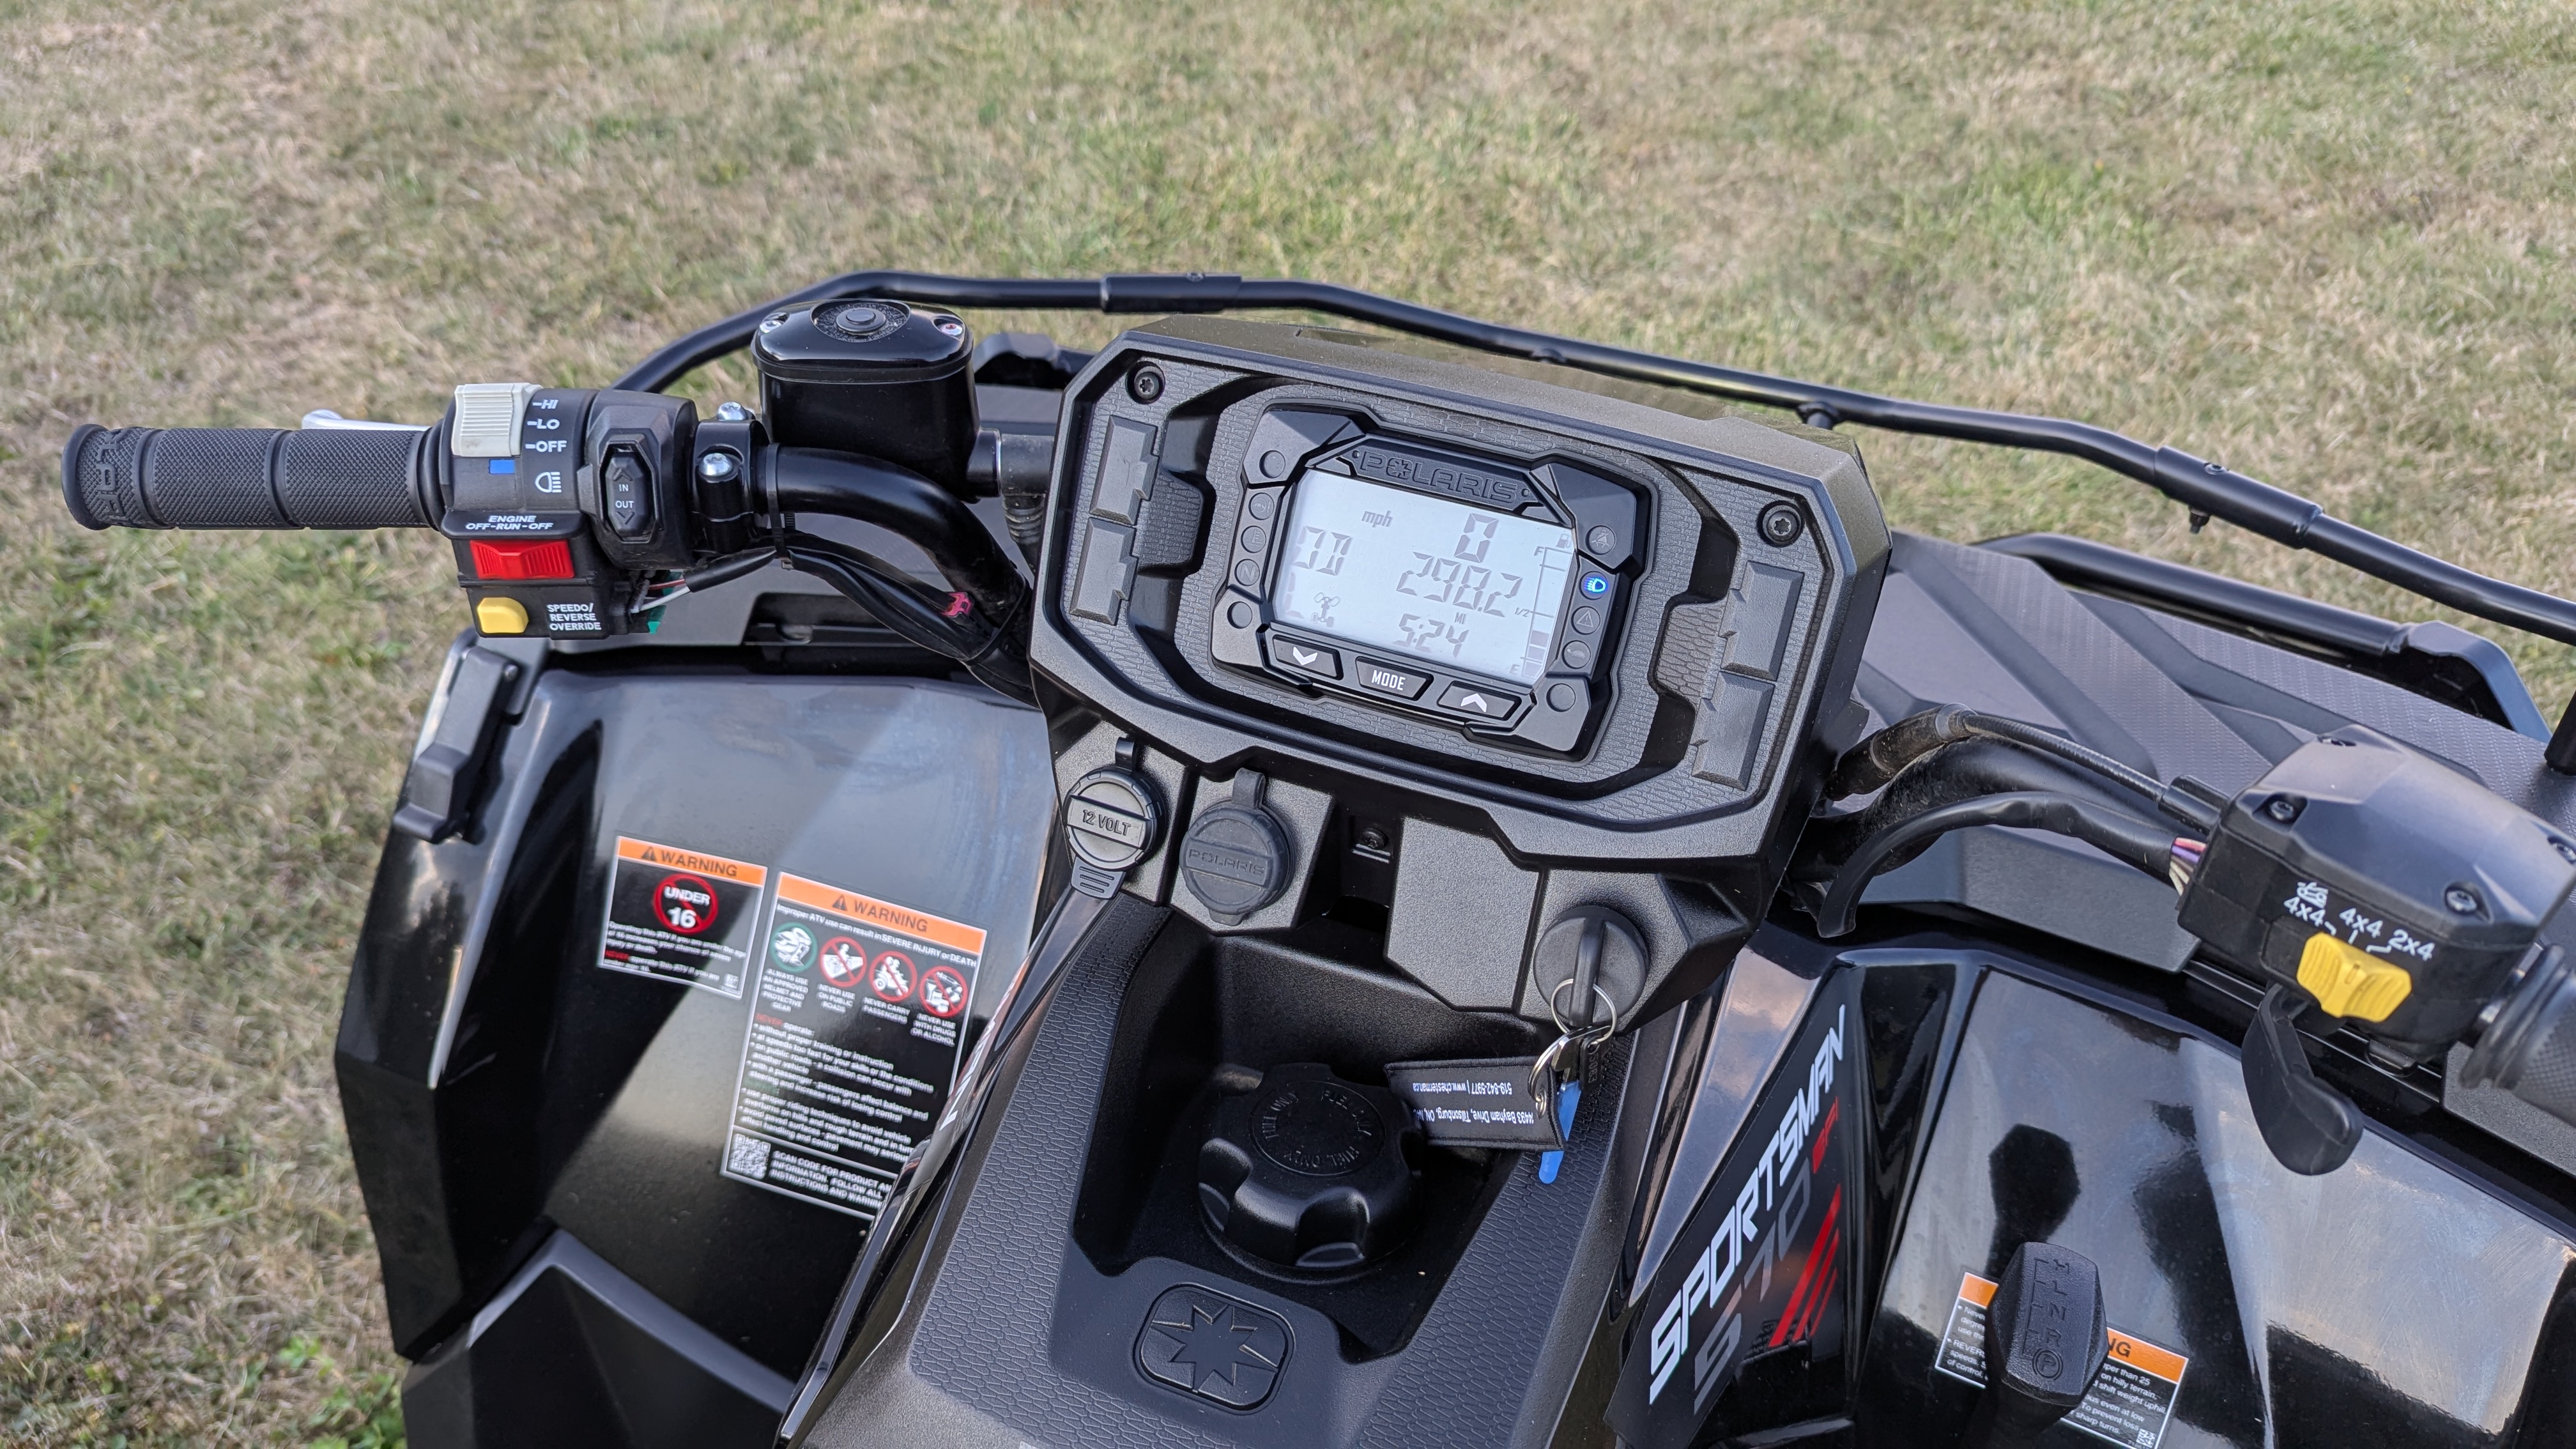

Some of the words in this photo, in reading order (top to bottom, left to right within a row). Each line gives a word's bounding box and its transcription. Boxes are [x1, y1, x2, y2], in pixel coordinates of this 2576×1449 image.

[542, 400, 558, 410] HI
[537, 419, 560, 430] LO
[536, 441, 567, 452] OFF
[1360, 453, 1521, 503] POLARIS
[619, 484, 629, 492] IN
[615, 500, 634, 509] OUT
[1361, 510, 1393, 528] mph
[1454, 513, 1499, 563] 0
[1534, 546, 1544, 556] F
[1396, 551, 1522, 618] 298.2
[547, 603, 594, 613] SPEEDO/
[549, 613, 596, 622] REVERSE
[1515, 607, 1530, 618] 1/2
[549, 622, 602, 631] OVERRIDE
[1455, 612, 1466, 624] MI
[1392, 613, 1469, 659] 5:24
[1371, 670, 1406, 691] MODE
[1082, 809, 1096, 825] 12
[1098, 814, 1131, 836] VOLT
[660, 850, 739, 877] WARNING
[1189, 848, 1265, 875] POLARIS
[663, 885, 710, 906] UNDER
[665, 905, 697, 930] 16
[852, 900, 929, 933] WARNING
[809, 912, 825, 924] ATV
[824, 918, 839, 928] use
[838, 923, 853, 932] can
[852, 925, 875, 939] result
[873, 931, 882, 940] in
[881, 933, 912, 949] SEVERE
[912, 942, 942, 958] INJURY
[940, 952, 950, 960] or
[949, 953, 976, 968] DEATH
[1471, 1082, 1512, 1095] 519-842-5977
[1490, 1108, 1517, 1124] Bayham
[1650, 1004, 1845, 1405] SPORTSMAN
[1694, 1156, 1812, 1414] 570
[2052, 1279, 2067, 1296] L
[2048, 1301, 2066, 1321] N
[2045, 1327, 2062, 1347] R
[2039, 1353, 2057, 1372] P
[2099, 1372, 2112, 1382] on
[2111, 1376, 2129, 1390] hilly
[2119, 1368, 2138, 1381] than
[2138, 1376, 2150, 1386] 25
[2097, 1381, 2117, 1394] shift
[2115, 1388, 2143, 1406] weight
[2074, 1411, 2099, 1426] sharp
[2080, 1401, 2092, 1411] To
[2092, 1407, 2122, 1425] prevent
[2122, 1419, 2140, 1431] loss
[2099, 1400, 2120, 1413] even
[2120, 1407, 2130, 1416] at
[2130, 1411, 2145, 1422] low
